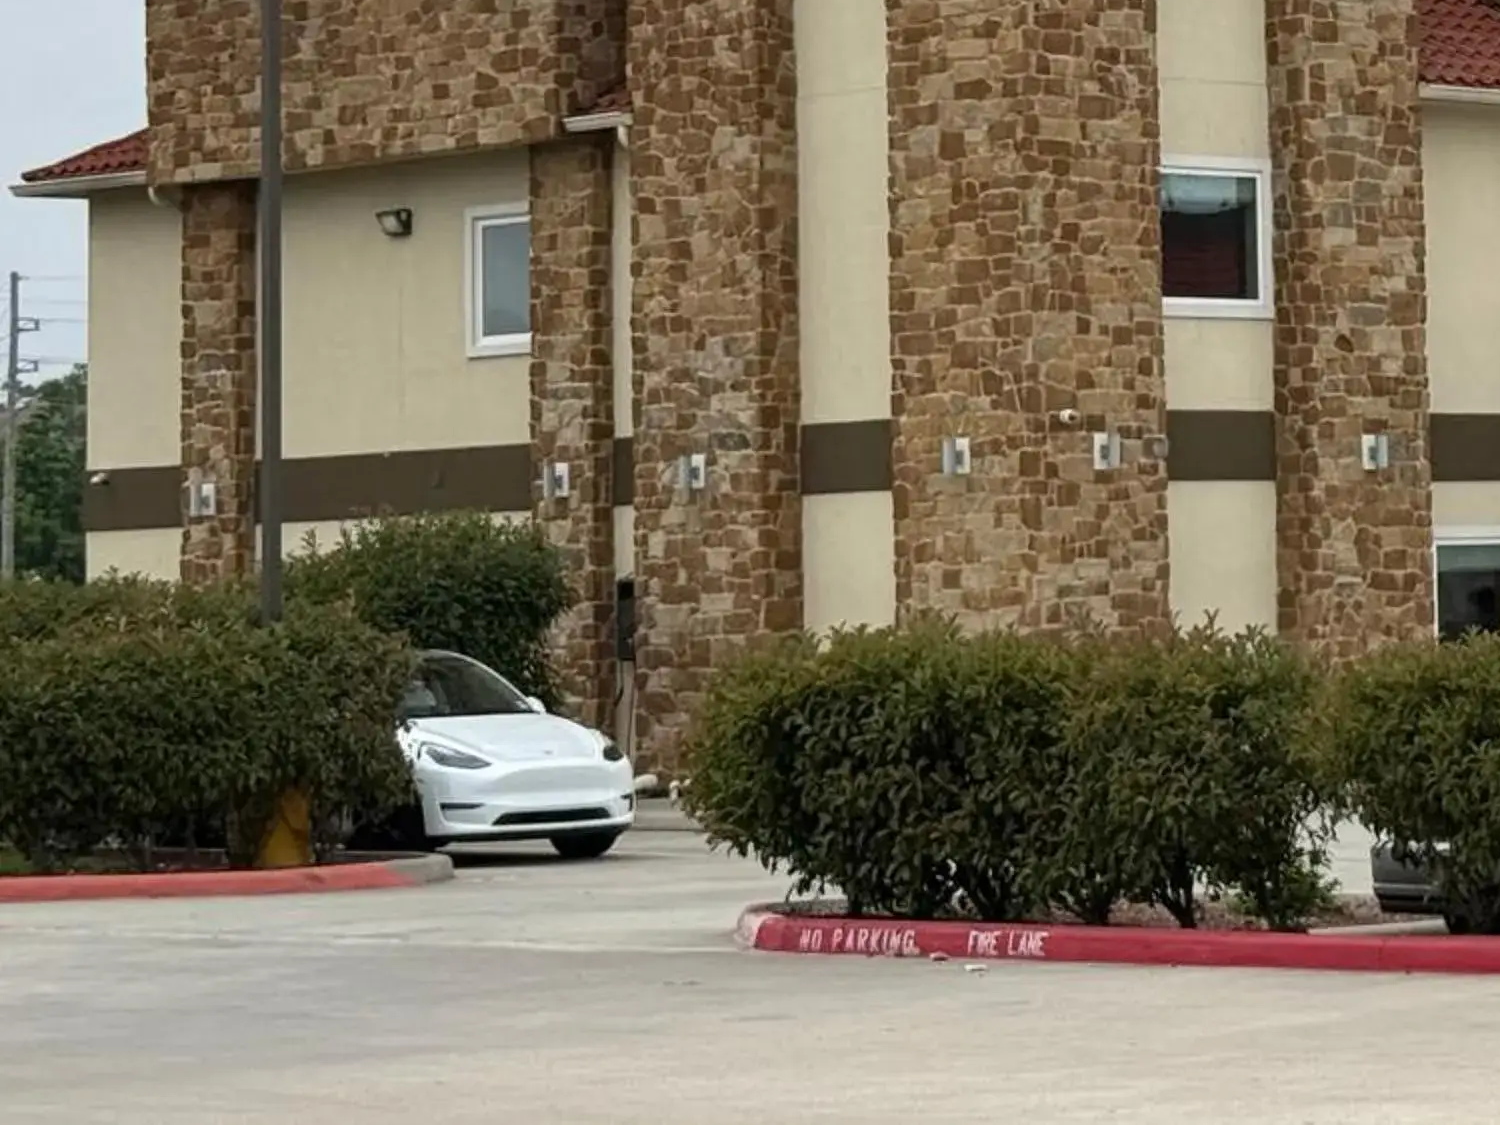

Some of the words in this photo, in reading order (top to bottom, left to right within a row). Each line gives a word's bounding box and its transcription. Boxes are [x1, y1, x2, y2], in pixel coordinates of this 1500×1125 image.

[800, 928, 822, 952] NO
[831, 928, 917, 955] PARKING
[967, 931, 1000, 957] FIRE
[1007, 931, 1050, 957] LANE
